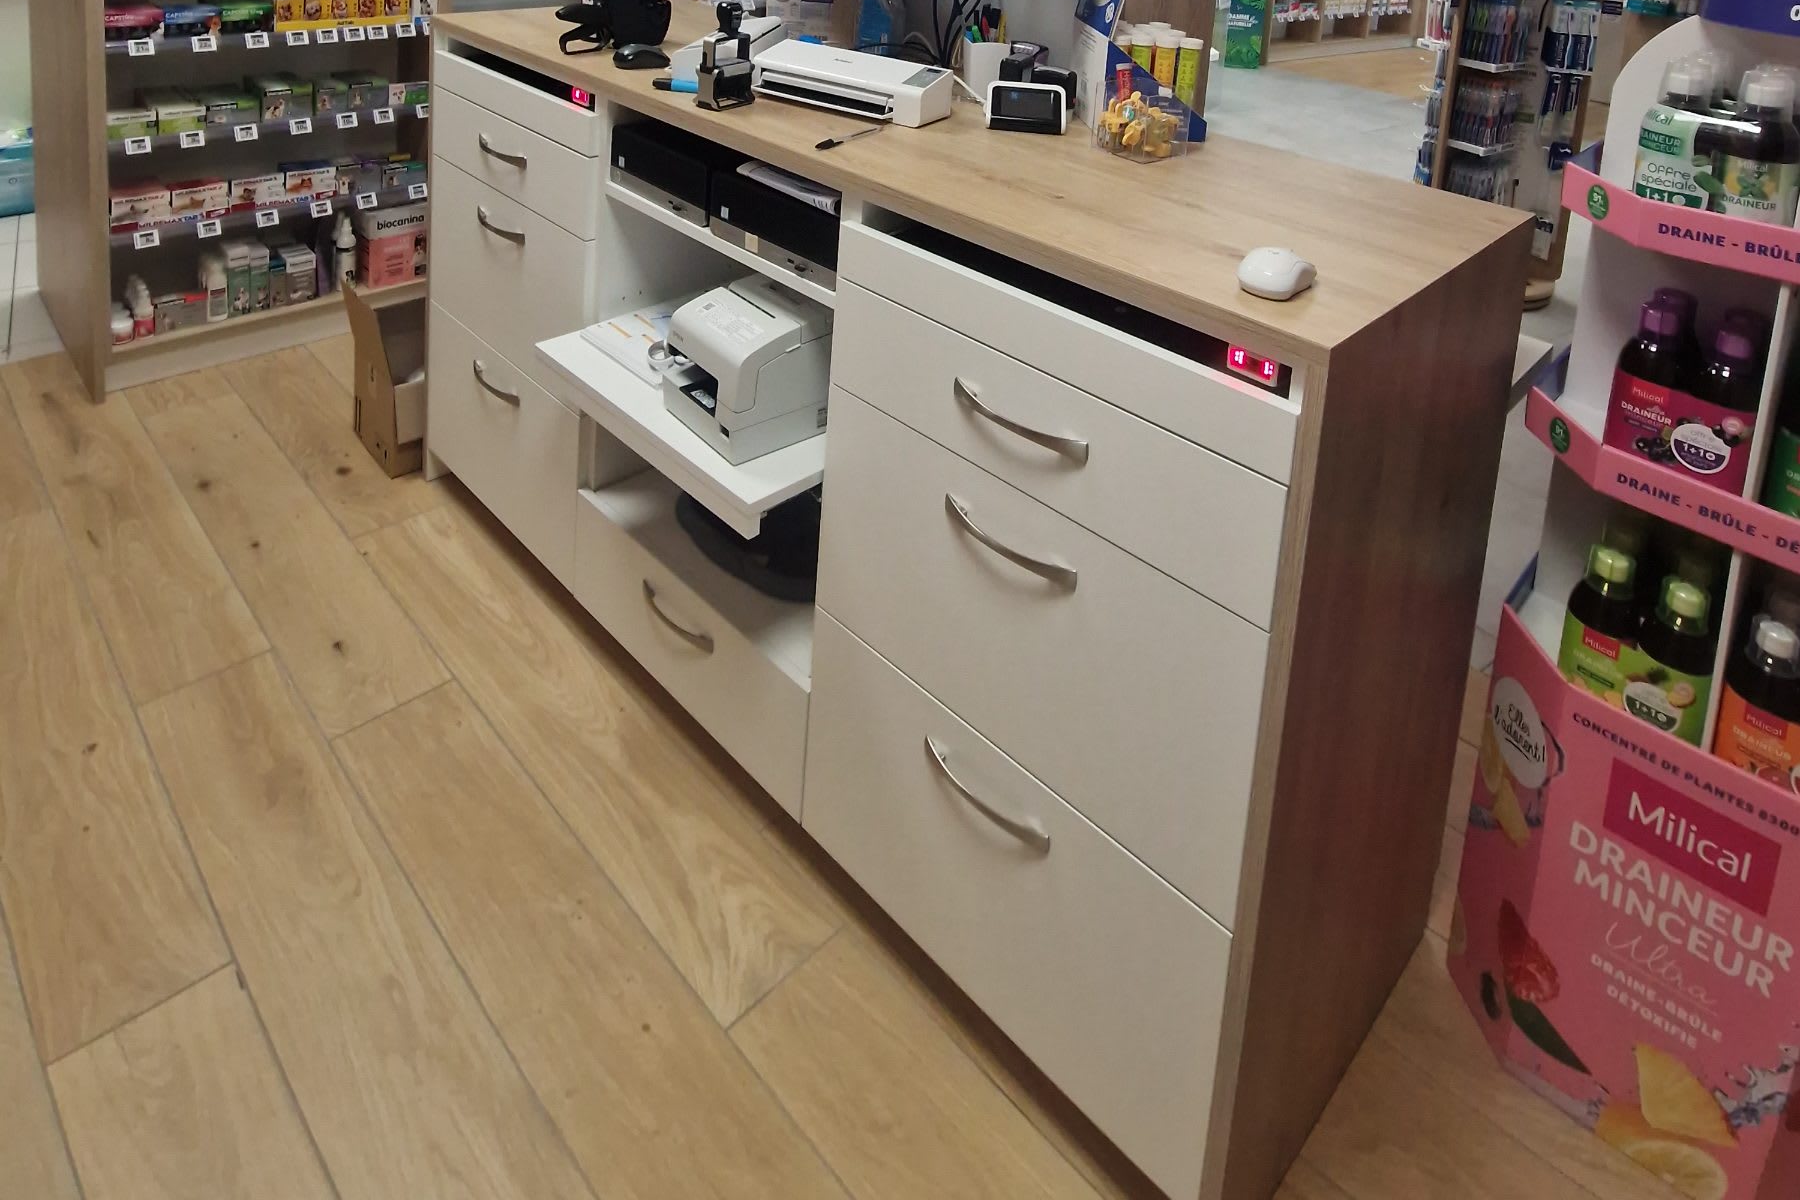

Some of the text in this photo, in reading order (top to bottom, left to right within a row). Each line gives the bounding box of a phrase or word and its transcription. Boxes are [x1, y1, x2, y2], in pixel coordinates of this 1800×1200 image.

[1641, 172, 1698, 194] spéciale
[1647, 162, 1691, 181] Offre
[376, 214, 425, 231] biocanina
[1657, 222, 1726, 248] DRAINE
[1744, 240, 1800, 264] BRÛLE
[1632, 386, 1664, 404] Milical
[1621, 401, 1672, 426] DRAINEUR
[1616, 472, 1681, 507] DRAINE
[1698, 505, 1757, 537] BRÛLE
[1585, 637, 1617, 659] Milical
[1746, 712, 1783, 738] Milical
[1572, 711, 1657, 764] CONCENTRÉ
[1661, 758, 1680, 777] DE
[1684, 770, 1754, 814] PLANTES
[1627, 791, 1752, 884] Milical
[1569, 820, 1794, 973] DRAINEUR
[1574, 858, 1775, 999] MINCEUR
[1606, 984, 1697, 1050] DÉTOXIFIE
